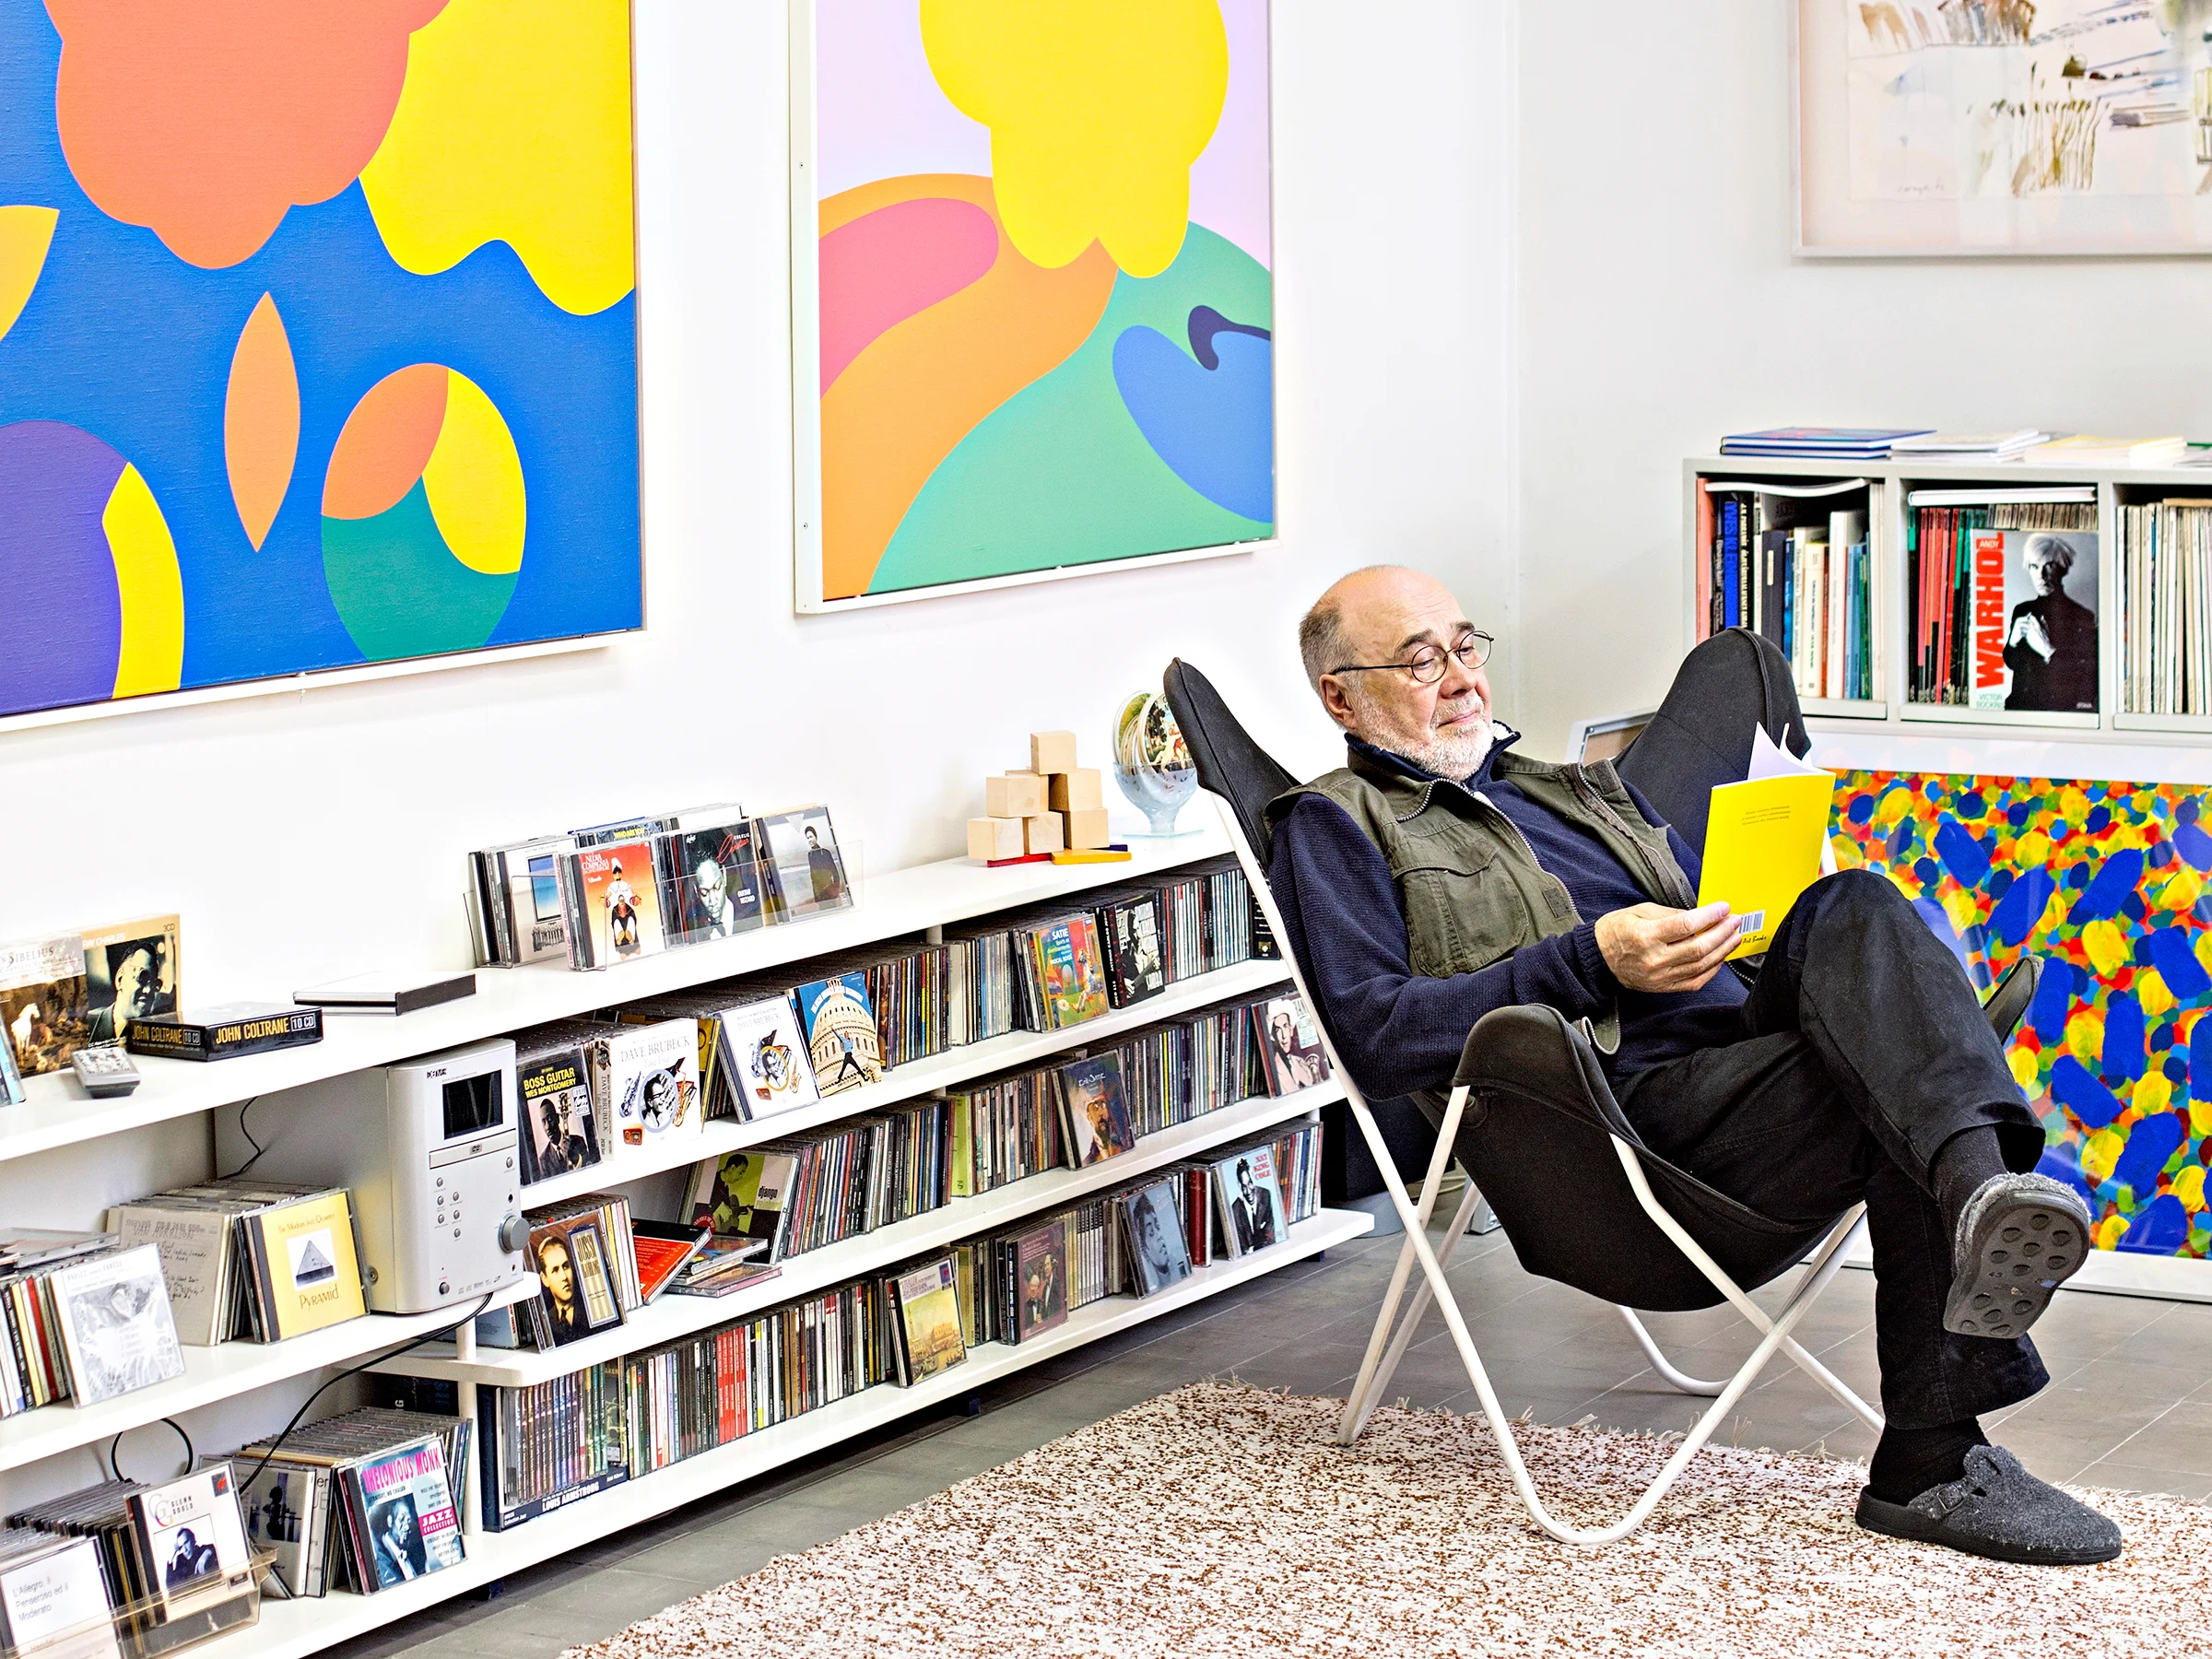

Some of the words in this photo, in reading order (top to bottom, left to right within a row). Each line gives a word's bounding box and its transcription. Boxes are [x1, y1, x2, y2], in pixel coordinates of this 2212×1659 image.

[1980, 540, 2000, 549] ANDY
[1976, 532, 2005, 689] WARHOL
[1979, 693, 2003, 701] VICTOR
[162, 923, 176, 933] 3CD
[1052, 927, 1069, 941] SATIE
[82, 937, 95, 948] RAY
[96, 933, 126, 947] CHARLES
[8, 946, 54, 967] SIBELIUS
[132, 1024, 150, 1042] JOHN
[150, 1026, 183, 1044] COLTRANE
[184, 1031, 192, 1043] 10
[216, 1026, 241, 1044] JOHN
[242, 1018, 290, 1040] COLTRANE
[292, 1016, 301, 1030] 10
[301, 1015, 314, 1028] CD
[620, 1046, 646, 1063] DAVE
[648, 1033, 690, 1055] BRUBECK
[524, 1075, 546, 1091] BOSS
[546, 1066, 576, 1084] GUITAR
[524, 1088, 538, 1099] WES
[538, 1077, 577, 1097] MONTGOMERY
[1253, 1161, 1270, 1172] KING
[1255, 1153, 1268, 1163] NAT
[1254, 1170, 1271, 1181] COLE
[758, 1185, 779, 1199] django
[361, 1455, 415, 1494] THELONIOUS
[414, 1447, 441, 1477] MONK
[171, 1495, 193, 1508] GLENN
[542, 1497, 561, 1512] LOUIS
[561, 1481, 600, 1505] ARMSTRONG
[172, 1502, 194, 1515] GOULD
[422, 1508, 453, 1527] JAZZ
[423, 1517, 454, 1535] COLLECTION
[15, 1590, 53, 1608] Penseroso
[53, 1584, 64, 1596] ed
[18, 1604, 52, 1622] Moderato
